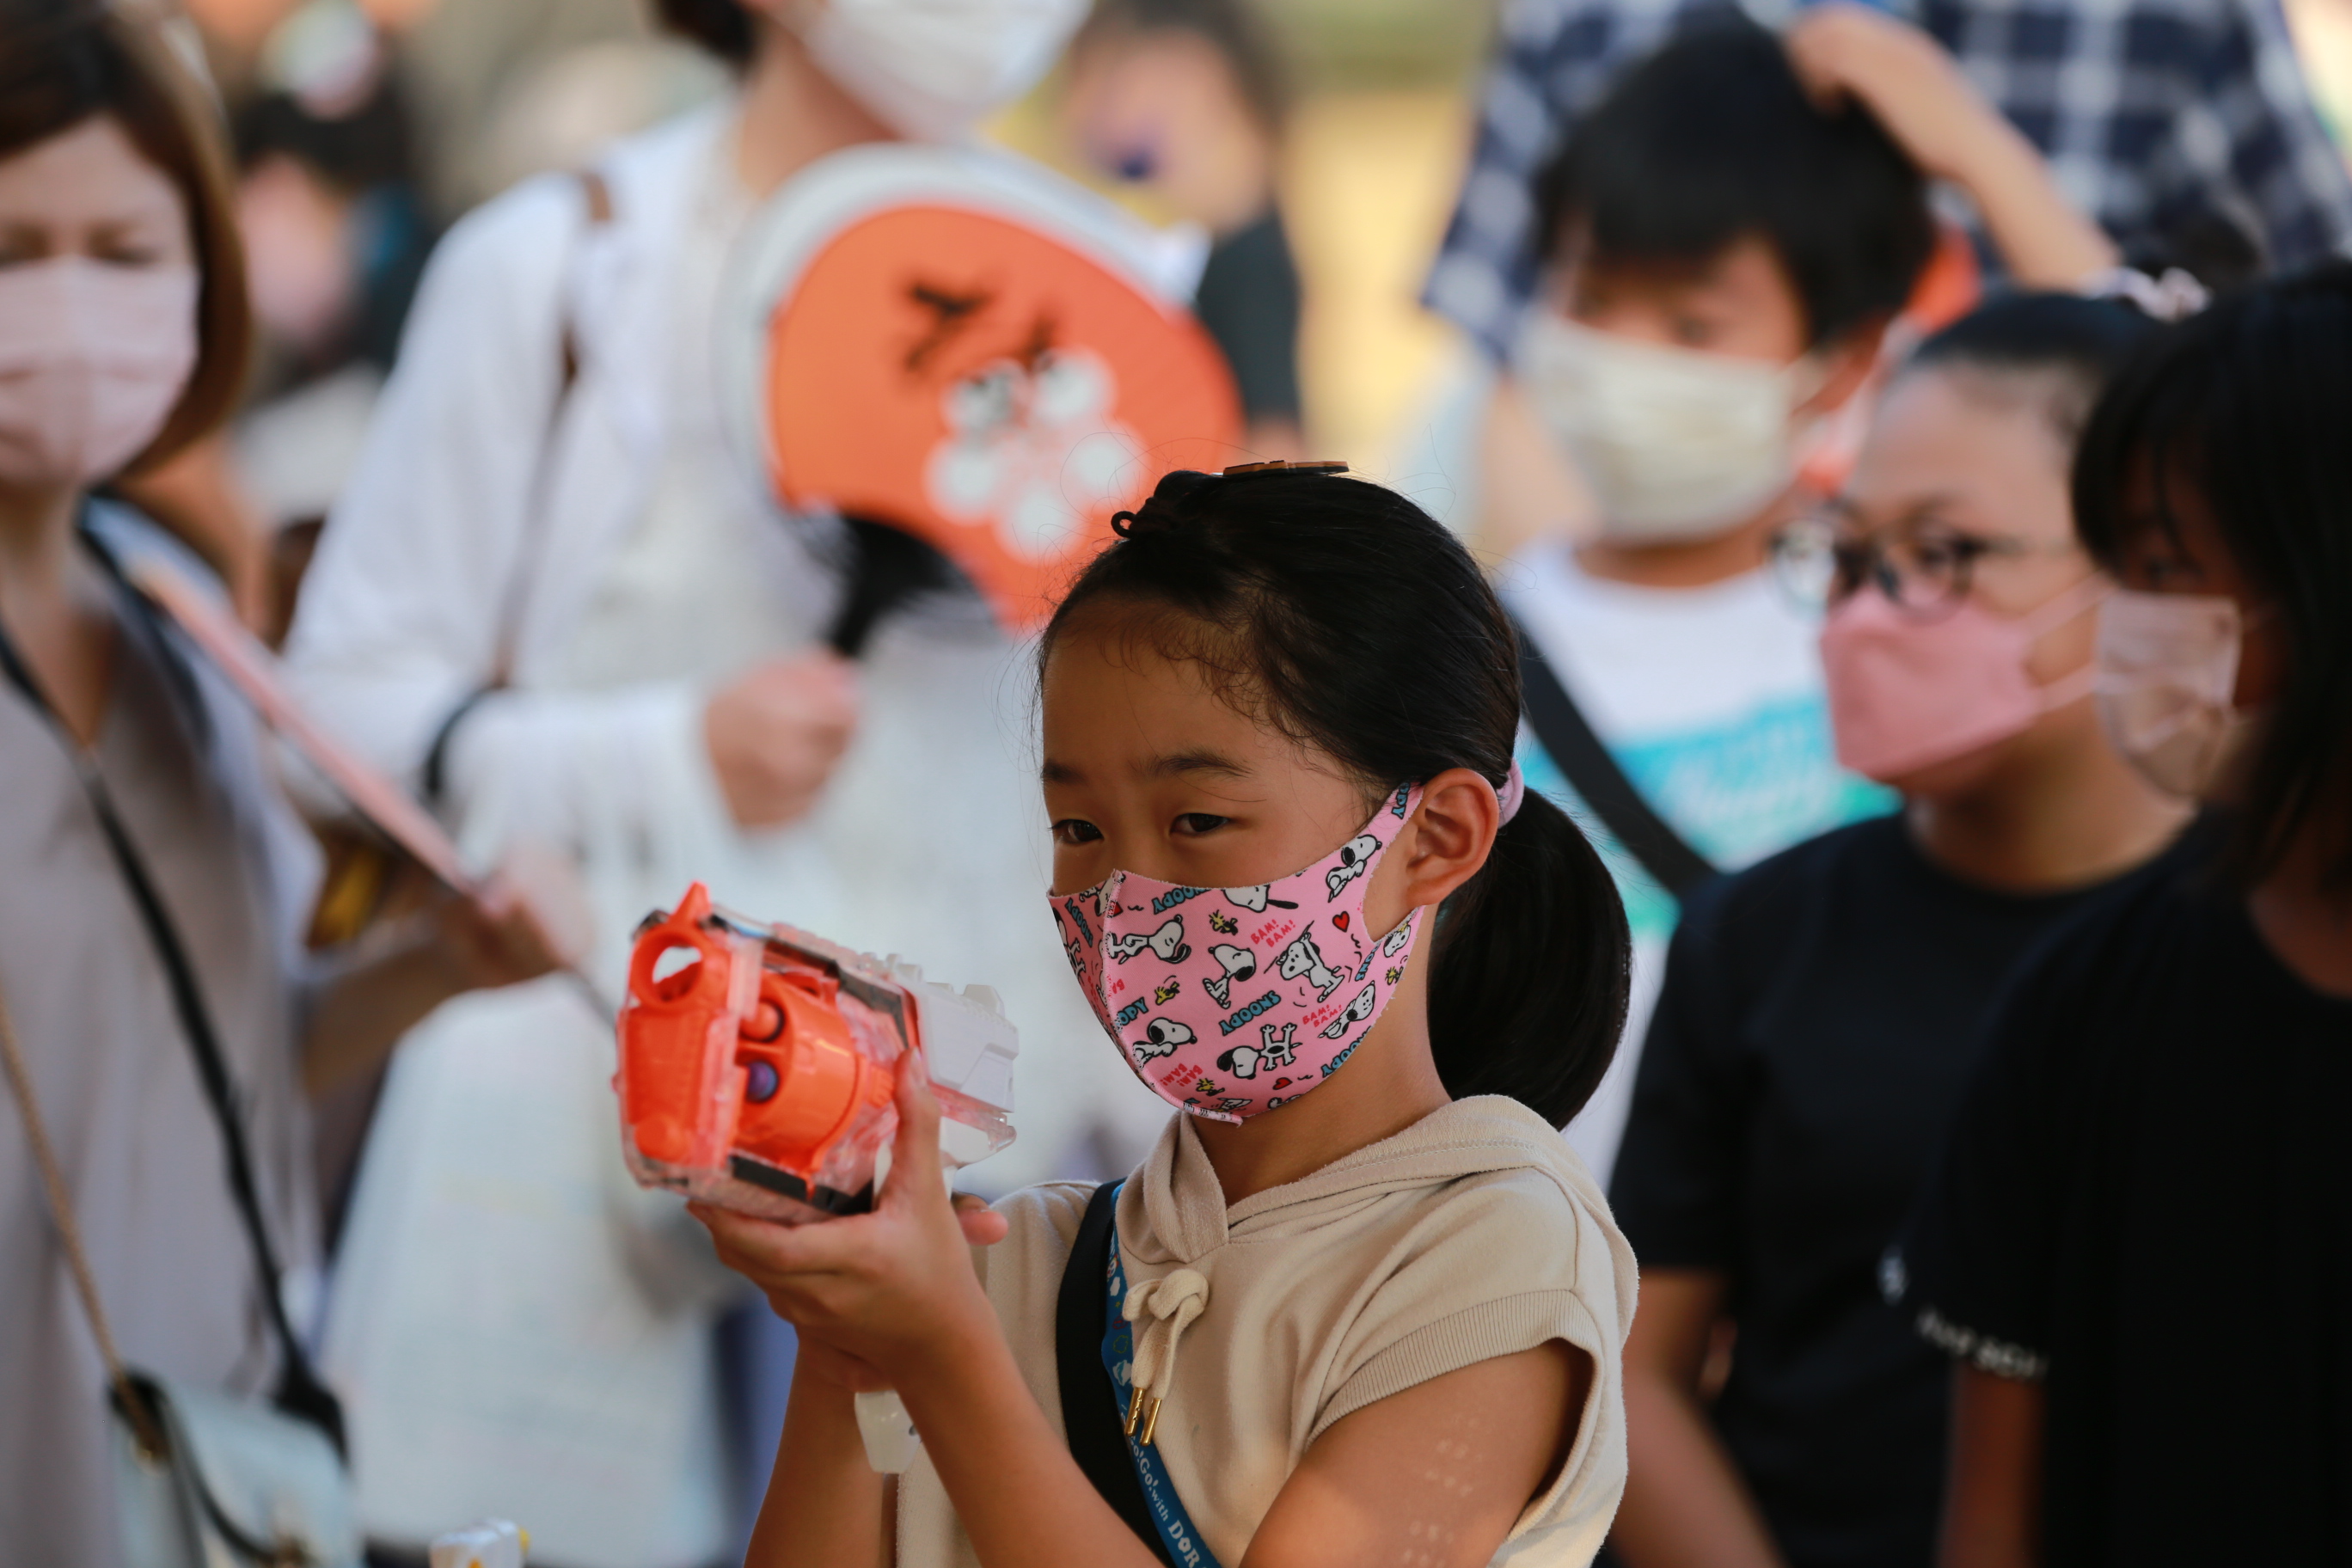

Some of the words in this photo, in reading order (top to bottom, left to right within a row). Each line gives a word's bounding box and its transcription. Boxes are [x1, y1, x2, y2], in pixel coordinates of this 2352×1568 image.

[1251, 919, 1279, 945] BAM!
[1265, 919, 1295, 948] BAM!
[1218, 990, 1282, 1037] SNOOPY
[1302, 1004, 1330, 1025] BAM!
[1314, 1004, 1342, 1028] BAM!
[1160, 1063, 1188, 1087] BAM!
[1176, 1064, 1204, 1087] BAM!
